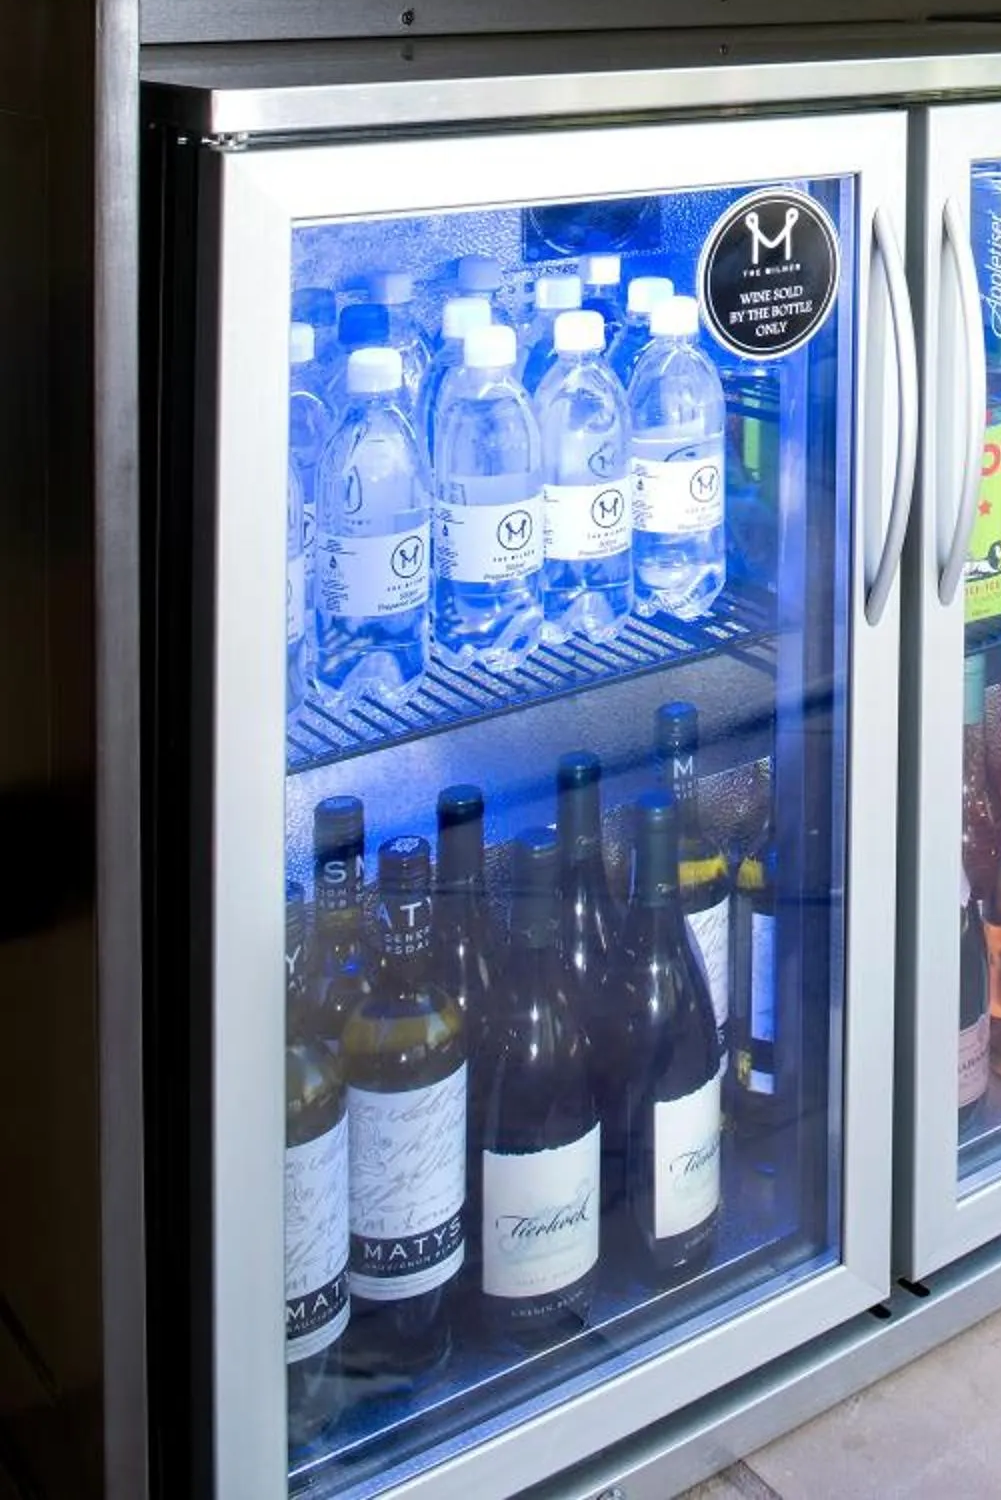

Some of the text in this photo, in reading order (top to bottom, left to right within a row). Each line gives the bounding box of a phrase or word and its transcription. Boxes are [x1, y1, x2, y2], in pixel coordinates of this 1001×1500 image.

[739, 285, 803, 304] WINE SOLD
[729, 300, 813, 325] BY THE BOTTLE
[755, 320, 788, 337] ONLY
[365, 1217, 461, 1260] MATYS
[287, 1282, 341, 1322] MAT
